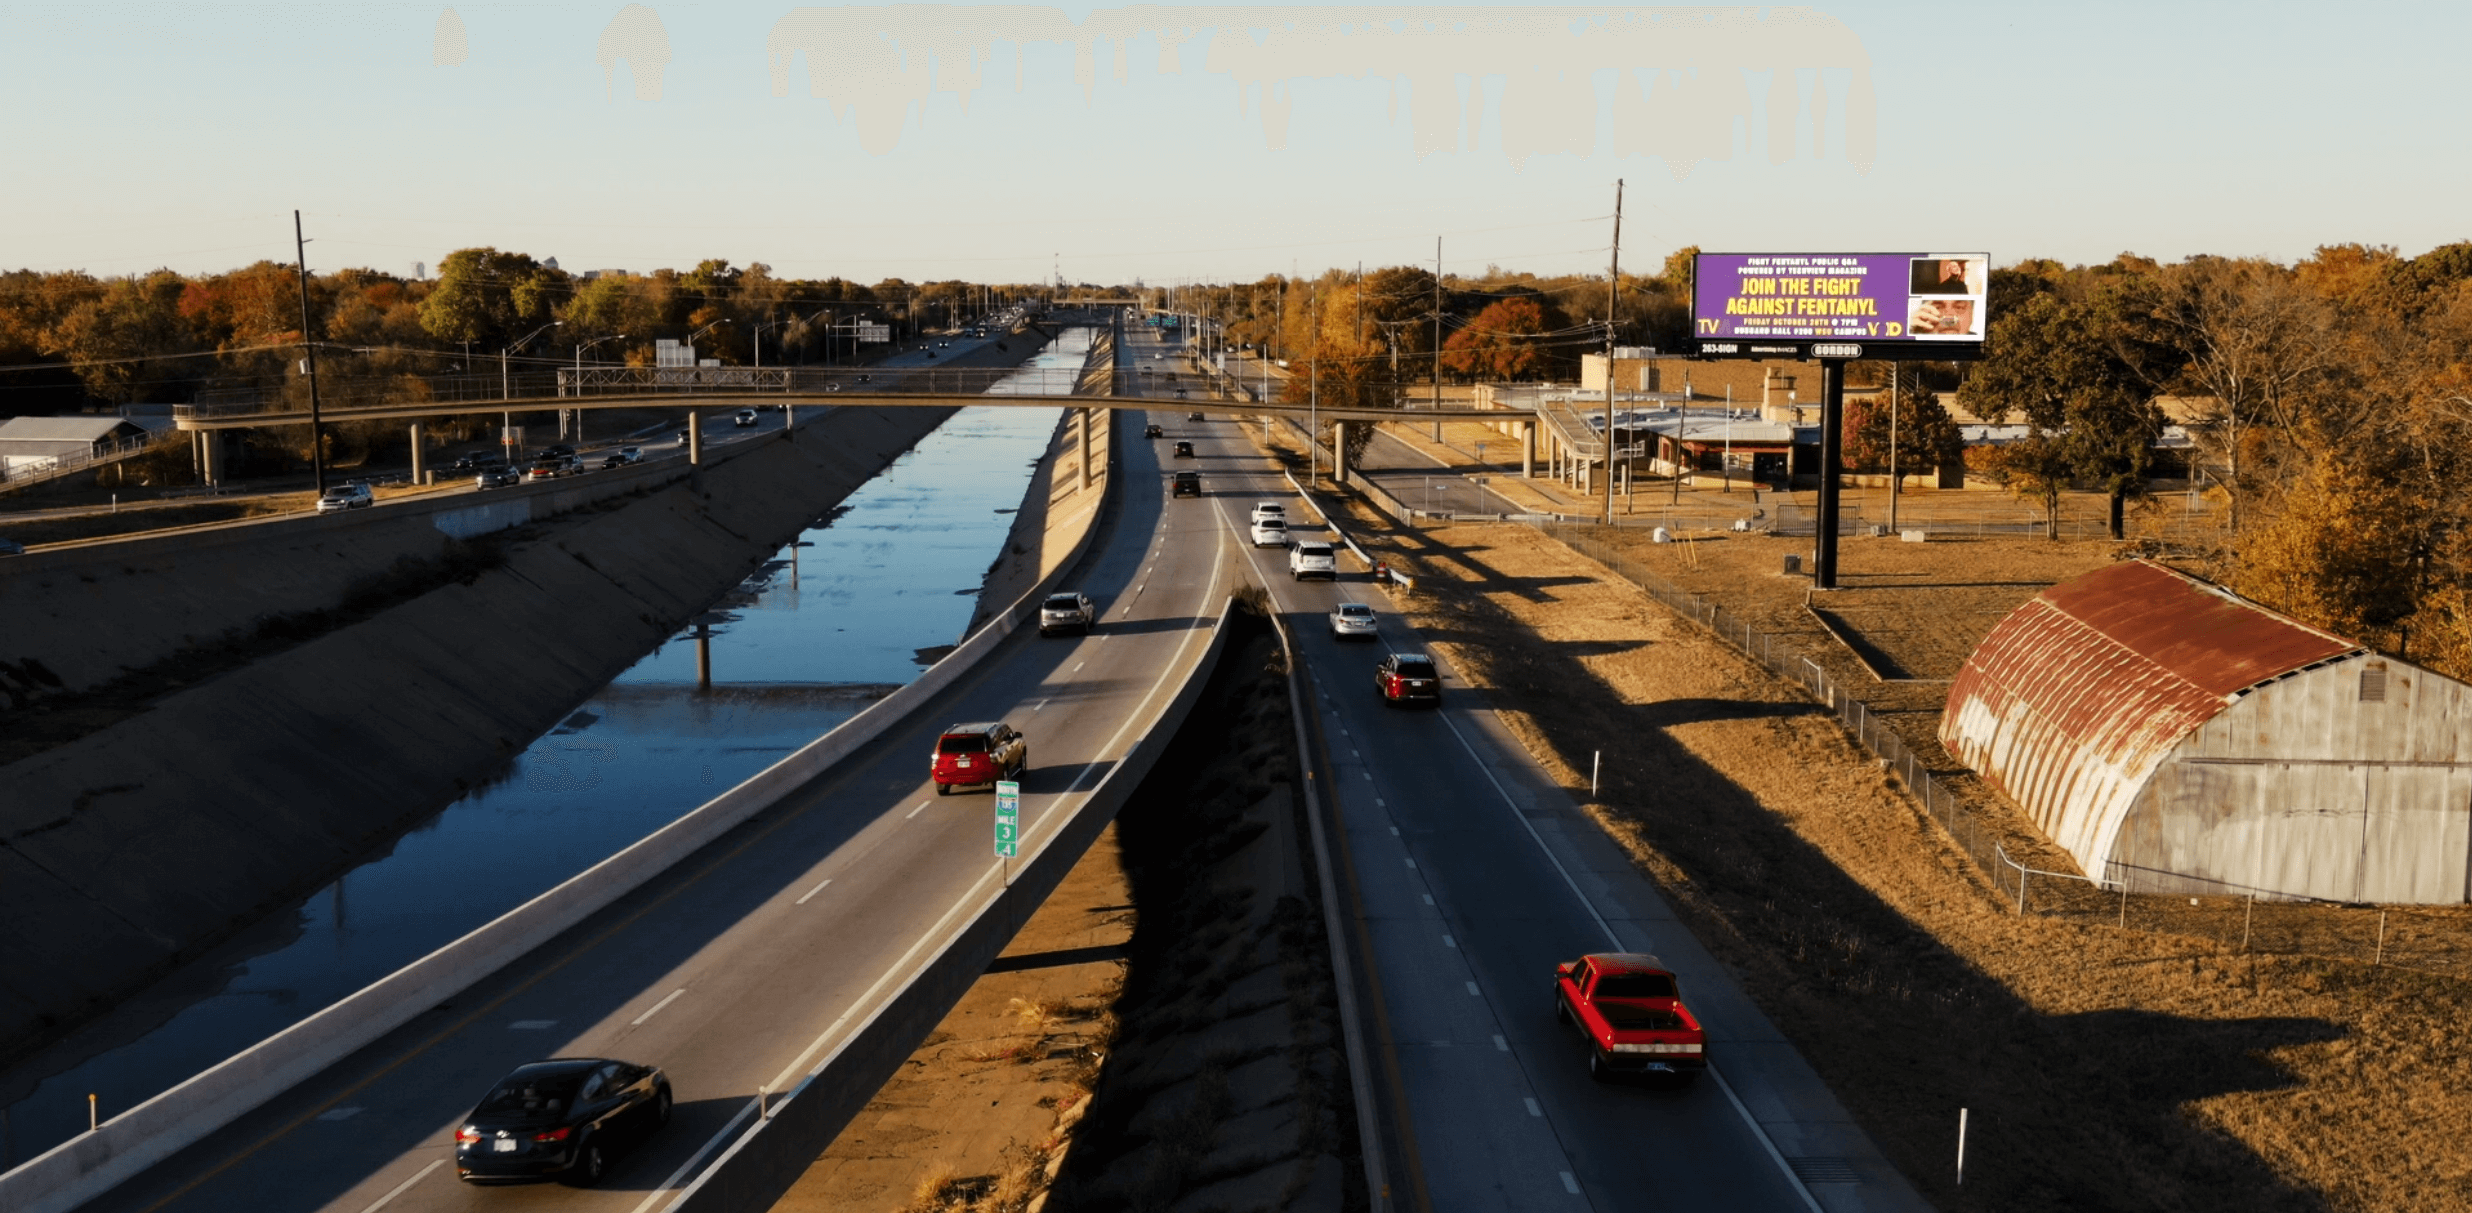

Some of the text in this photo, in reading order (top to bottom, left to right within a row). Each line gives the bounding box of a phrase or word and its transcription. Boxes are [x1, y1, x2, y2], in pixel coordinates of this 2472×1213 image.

[1828, 267, 1867, 275] MAGAZINE
[1741, 278, 1861, 295] JOIN THE FIGHT
[1726, 298, 1877, 315] AGAINST FENTANYL
[1744, 318, 1770, 326] FRIDAY
[1773, 318, 1807, 326] OCTOBER
[1772, 327, 1792, 335] HALL
[1834, 328, 1867, 336] CAMPUS
[1702, 343, 1738, 353] 263-SIGN
[1814, 345, 1859, 355] GORDON
[1002, 827, 1011, 839] 3
